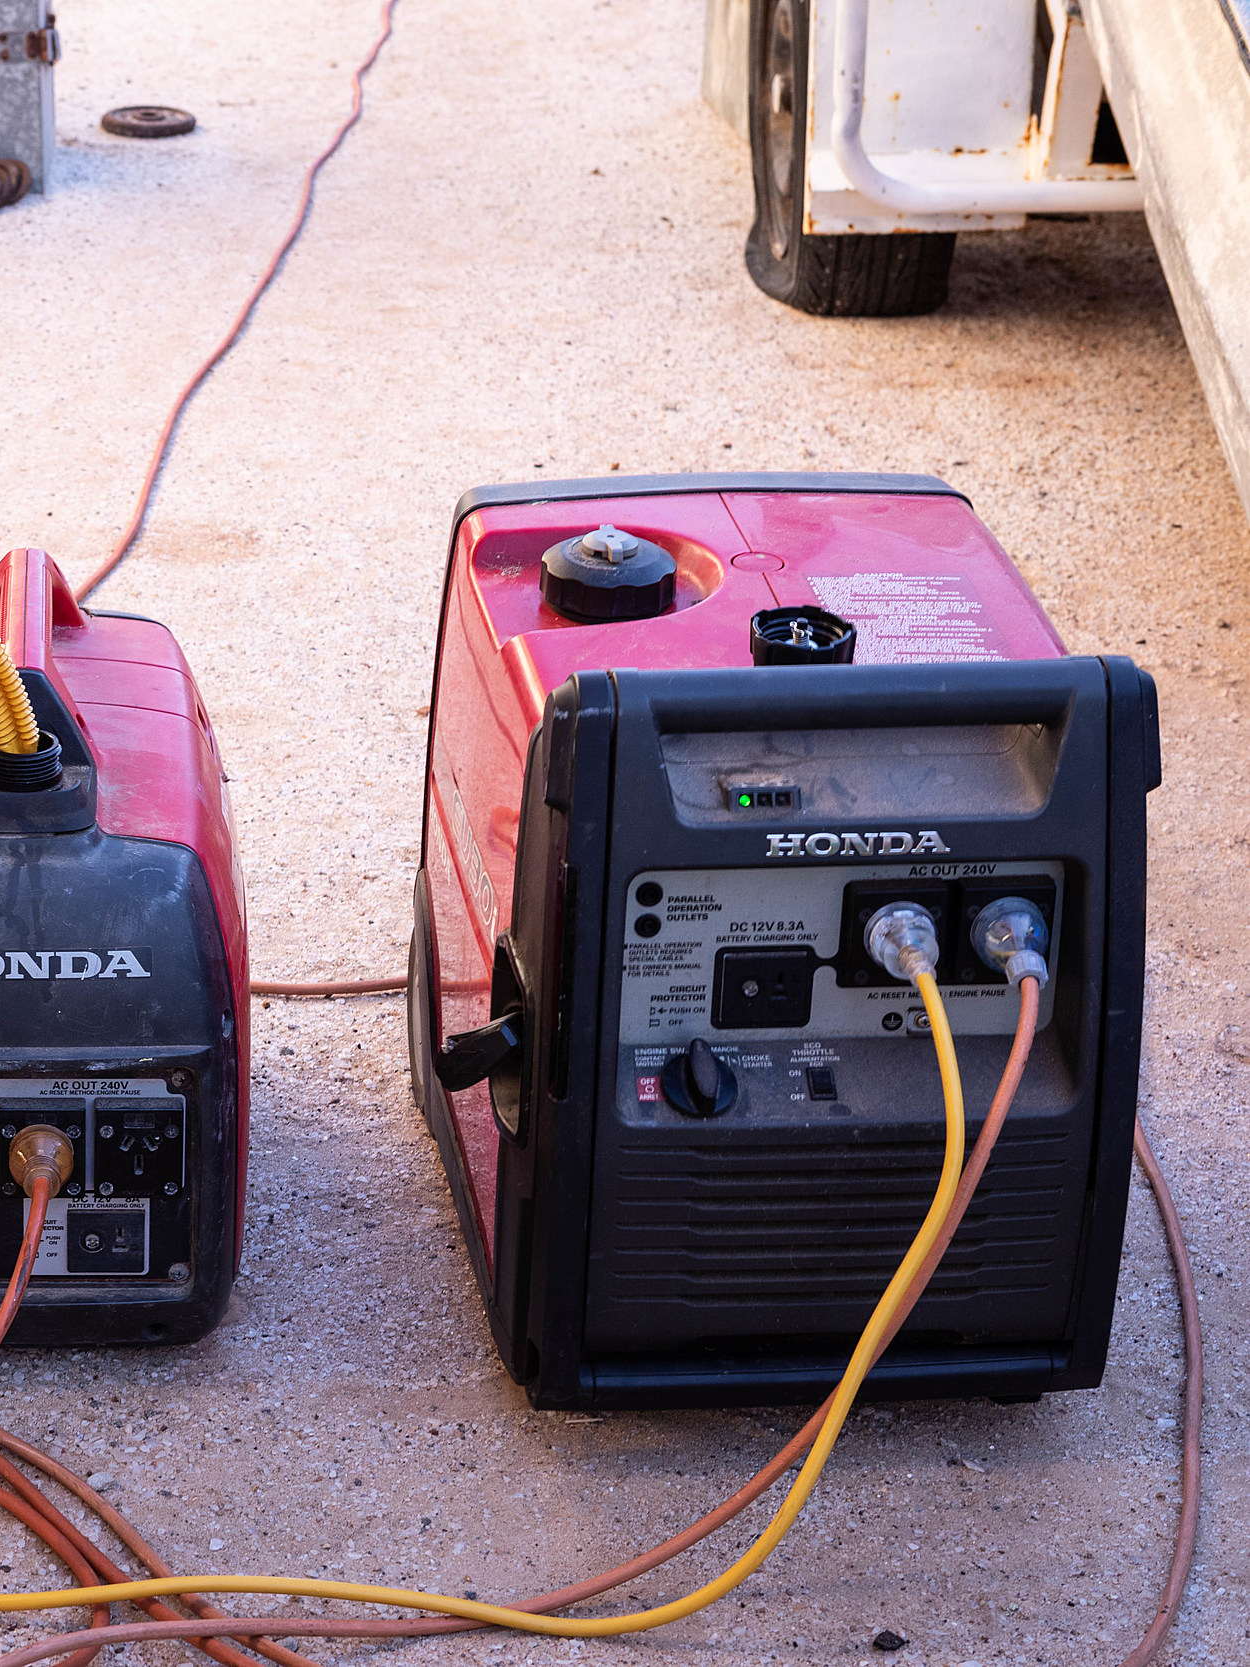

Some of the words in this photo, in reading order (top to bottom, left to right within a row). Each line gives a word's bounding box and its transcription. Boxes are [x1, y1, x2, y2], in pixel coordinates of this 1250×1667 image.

[766, 830, 950, 857] HONDA
[909, 864, 928, 877] AC
[931, 864, 959, 876] OUT
[962, 863, 997, 876] 240V
[667, 895, 715, 904] PARALLEL
[667, 903, 722, 913] OPERATION
[667, 912, 709, 921] OUTLETS
[730, 922, 748, 933] DC
[751, 921, 776, 932] 12V
[777, 920, 805, 932] 8.3A
[716, 934, 751, 943] BATTERY
[753, 934, 796, 942] CHARGING
[797, 933, 818, 942] ONLY
[669, 985, 707, 993] CIRCUIT
[650, 994, 706, 1002] PROTECTOR
[867, 992, 878, 1000] AC
[881, 991, 905, 999] RESET
[950, 989, 978, 998] ENGINE
[981, 989, 1007, 997] PAUSE
[634, 1047, 668, 1055] ENGINE
[792, 1048, 835, 1056] THROTTLE
[742, 1054, 770, 1062] CHOKE
[743, 1061, 773, 1069] STARTER
[789, 1069, 802, 1077] ON
[640, 1077, 656, 1085] OFF
[52, 1081, 69, 1089] AC
[72, 1081, 98, 1089] OUT
[100, 1081, 129, 1090] 240V
[790, 1093, 806, 1101] OFF
